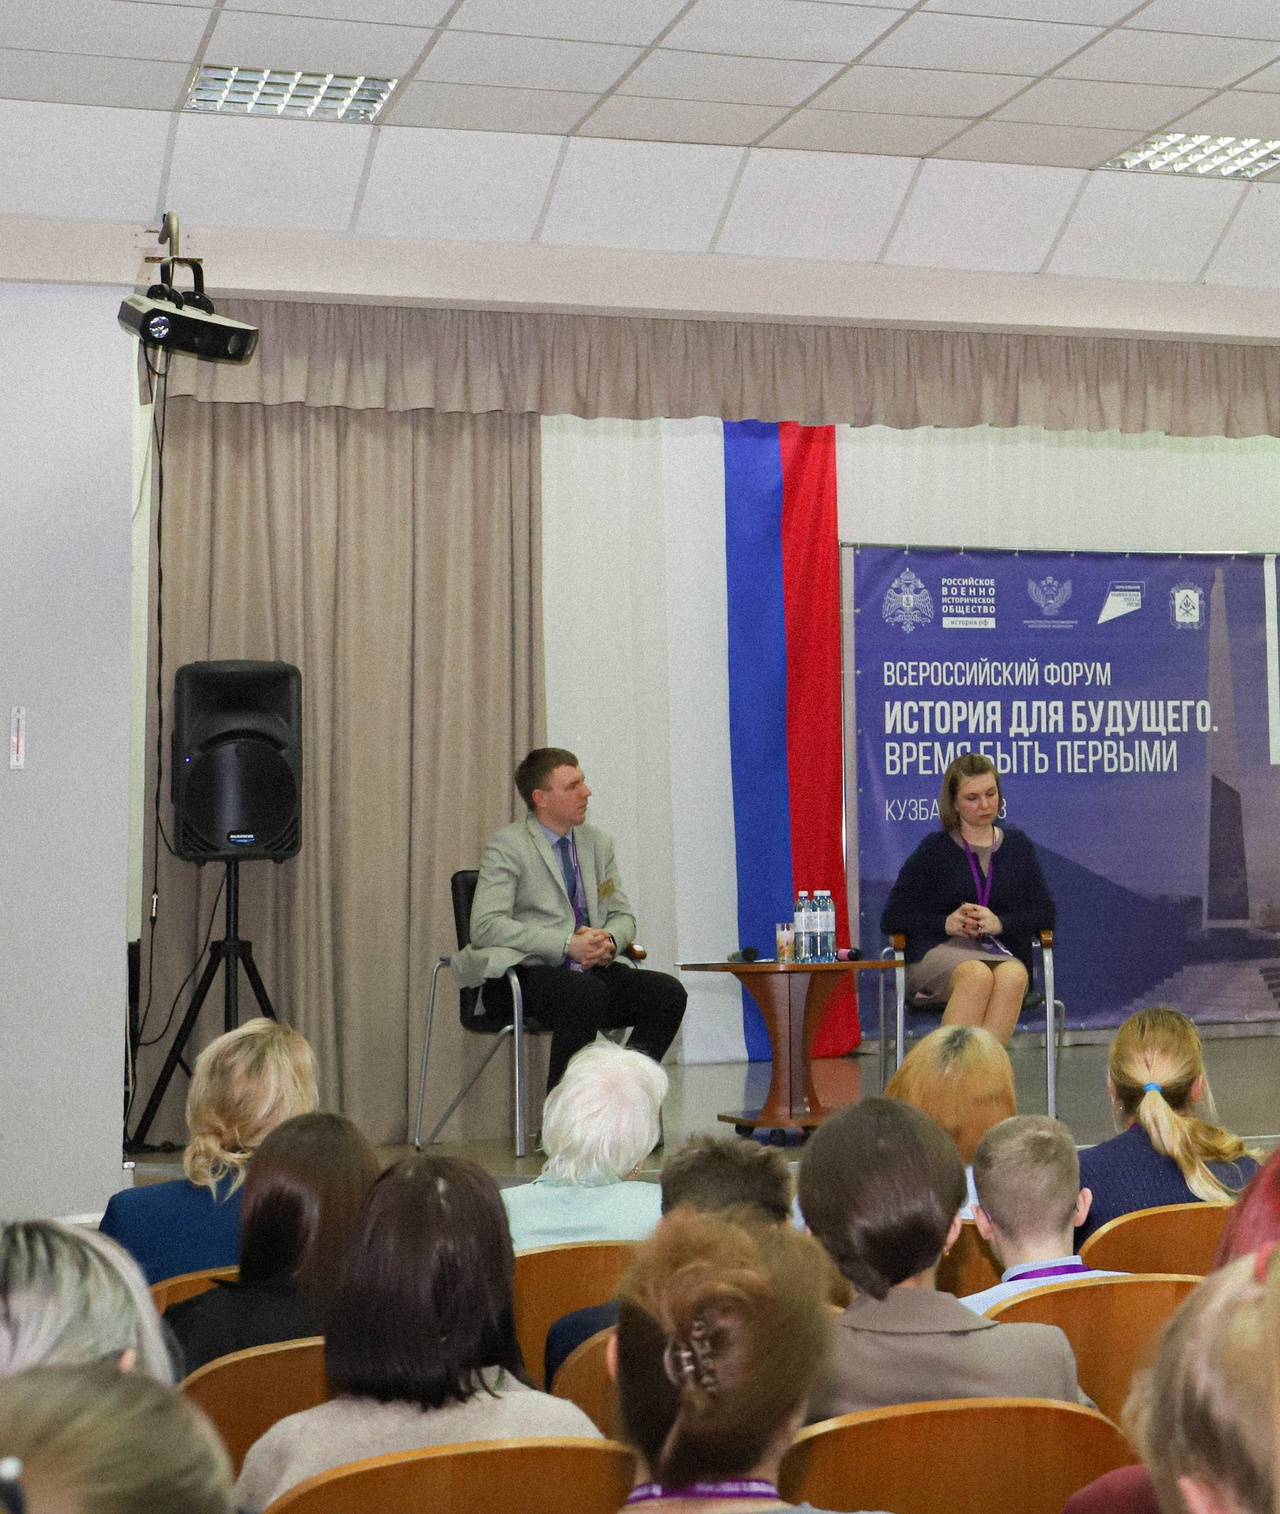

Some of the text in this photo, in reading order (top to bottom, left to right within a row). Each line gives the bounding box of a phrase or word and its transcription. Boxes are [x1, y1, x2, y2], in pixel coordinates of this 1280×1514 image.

[941, 577, 995, 586] РОССИЙСКОЕ
[941, 587, 996, 596] ВОЕННО
[941, 605, 996, 615] ОБЩЕСТВО
[883, 658, 1111, 686] ВСЕРОССИЙСКИЙ ФОРУМ
[884, 699, 1219, 737] ИСТОРИЯ ДЛЯ БУДУЩЕГО.
[1056, 739, 1178, 774] ПЕРВЫМИ
[885, 798, 941, 821] КУЗБА
